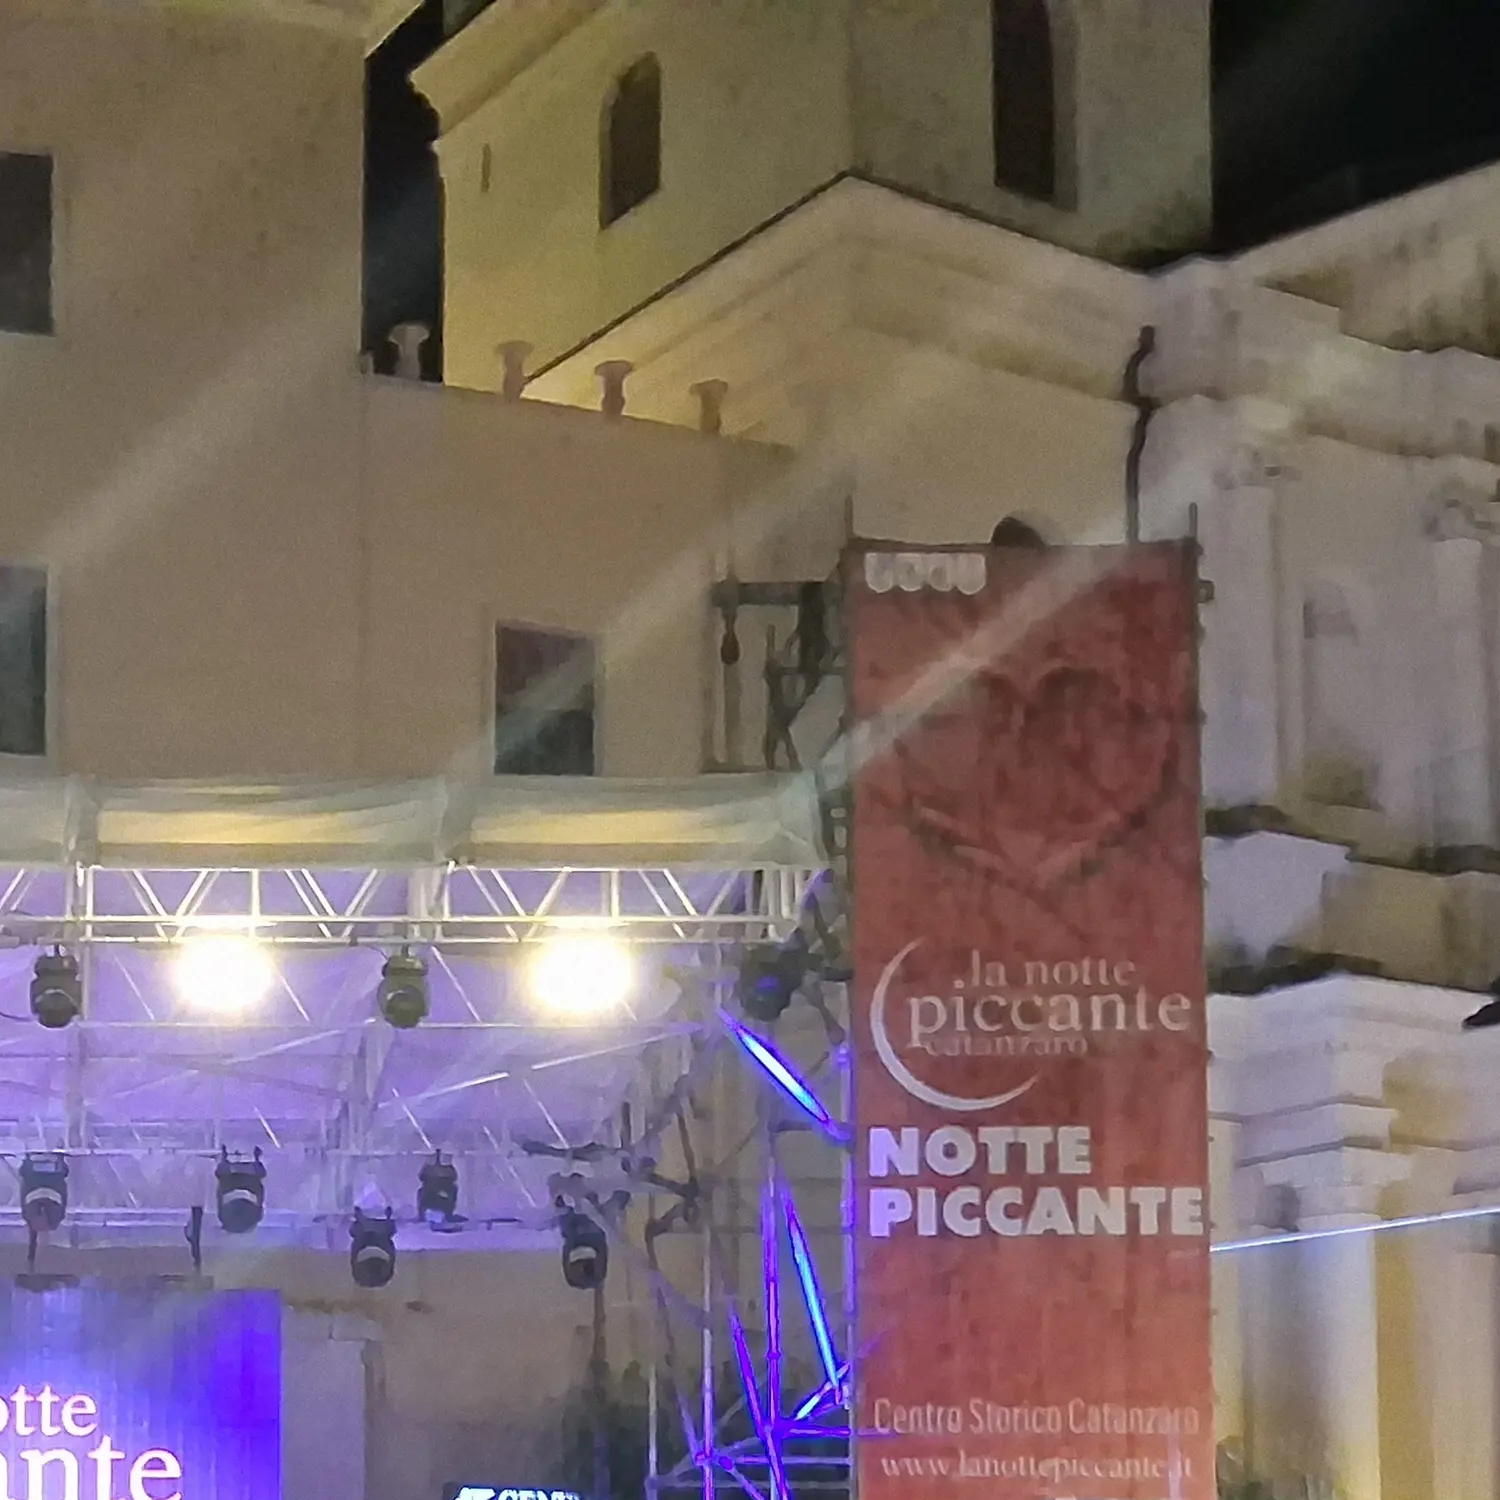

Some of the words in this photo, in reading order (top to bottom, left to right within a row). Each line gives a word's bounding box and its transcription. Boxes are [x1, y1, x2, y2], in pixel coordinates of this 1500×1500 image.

[971, 949, 1008, 988] la
[1024, 955, 1137, 987] notte
[907, 980, 1192, 1049] piccante
[867, 1124, 1092, 1178] NOTTE
[867, 1185, 1204, 1238] PICCANTE
[872, 1396, 963, 1436] Centro
[967, 1396, 1063, 1436] Storico
